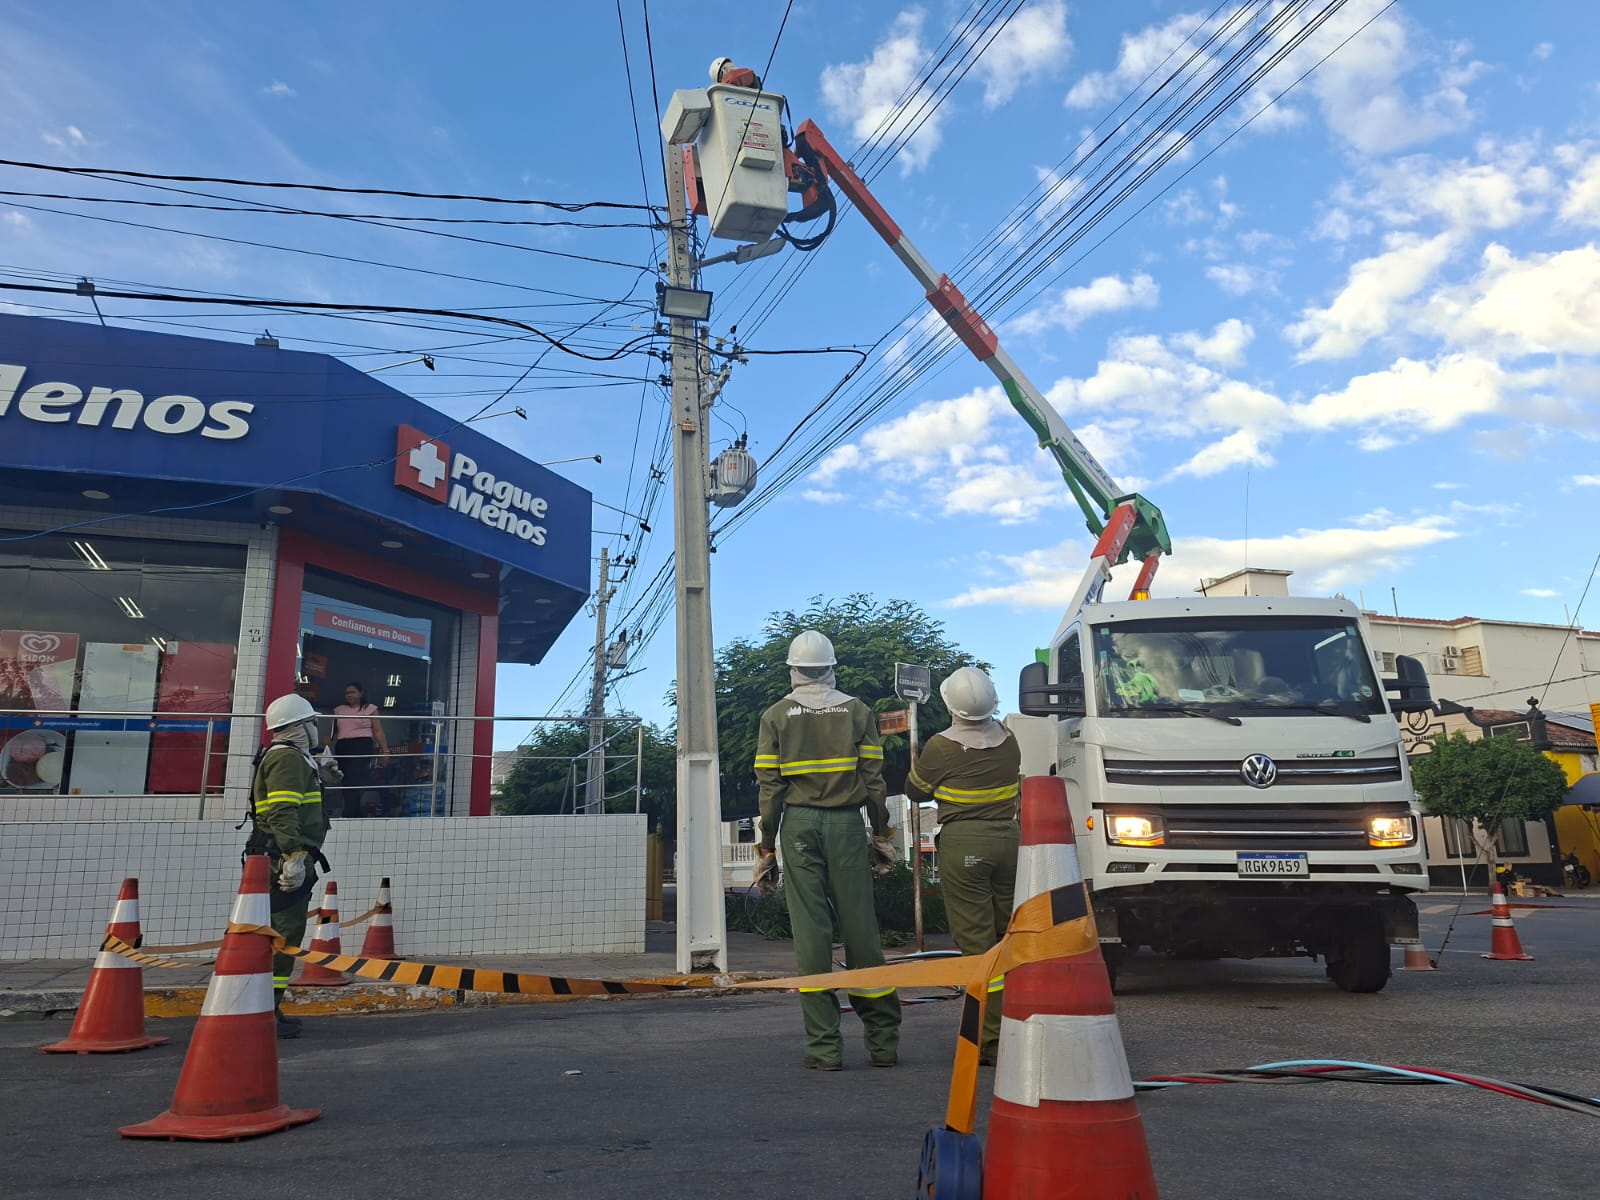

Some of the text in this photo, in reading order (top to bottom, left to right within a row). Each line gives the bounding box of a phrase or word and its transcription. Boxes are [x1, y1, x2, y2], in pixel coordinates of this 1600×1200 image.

[451, 452, 548, 519] Pague
[448, 484, 548, 547] Menos
[331, 615, 412, 644] Confiamos em Deus
[20, 654, 55, 663] KIBON
[1244, 860, 1301, 872] RGK9A59
